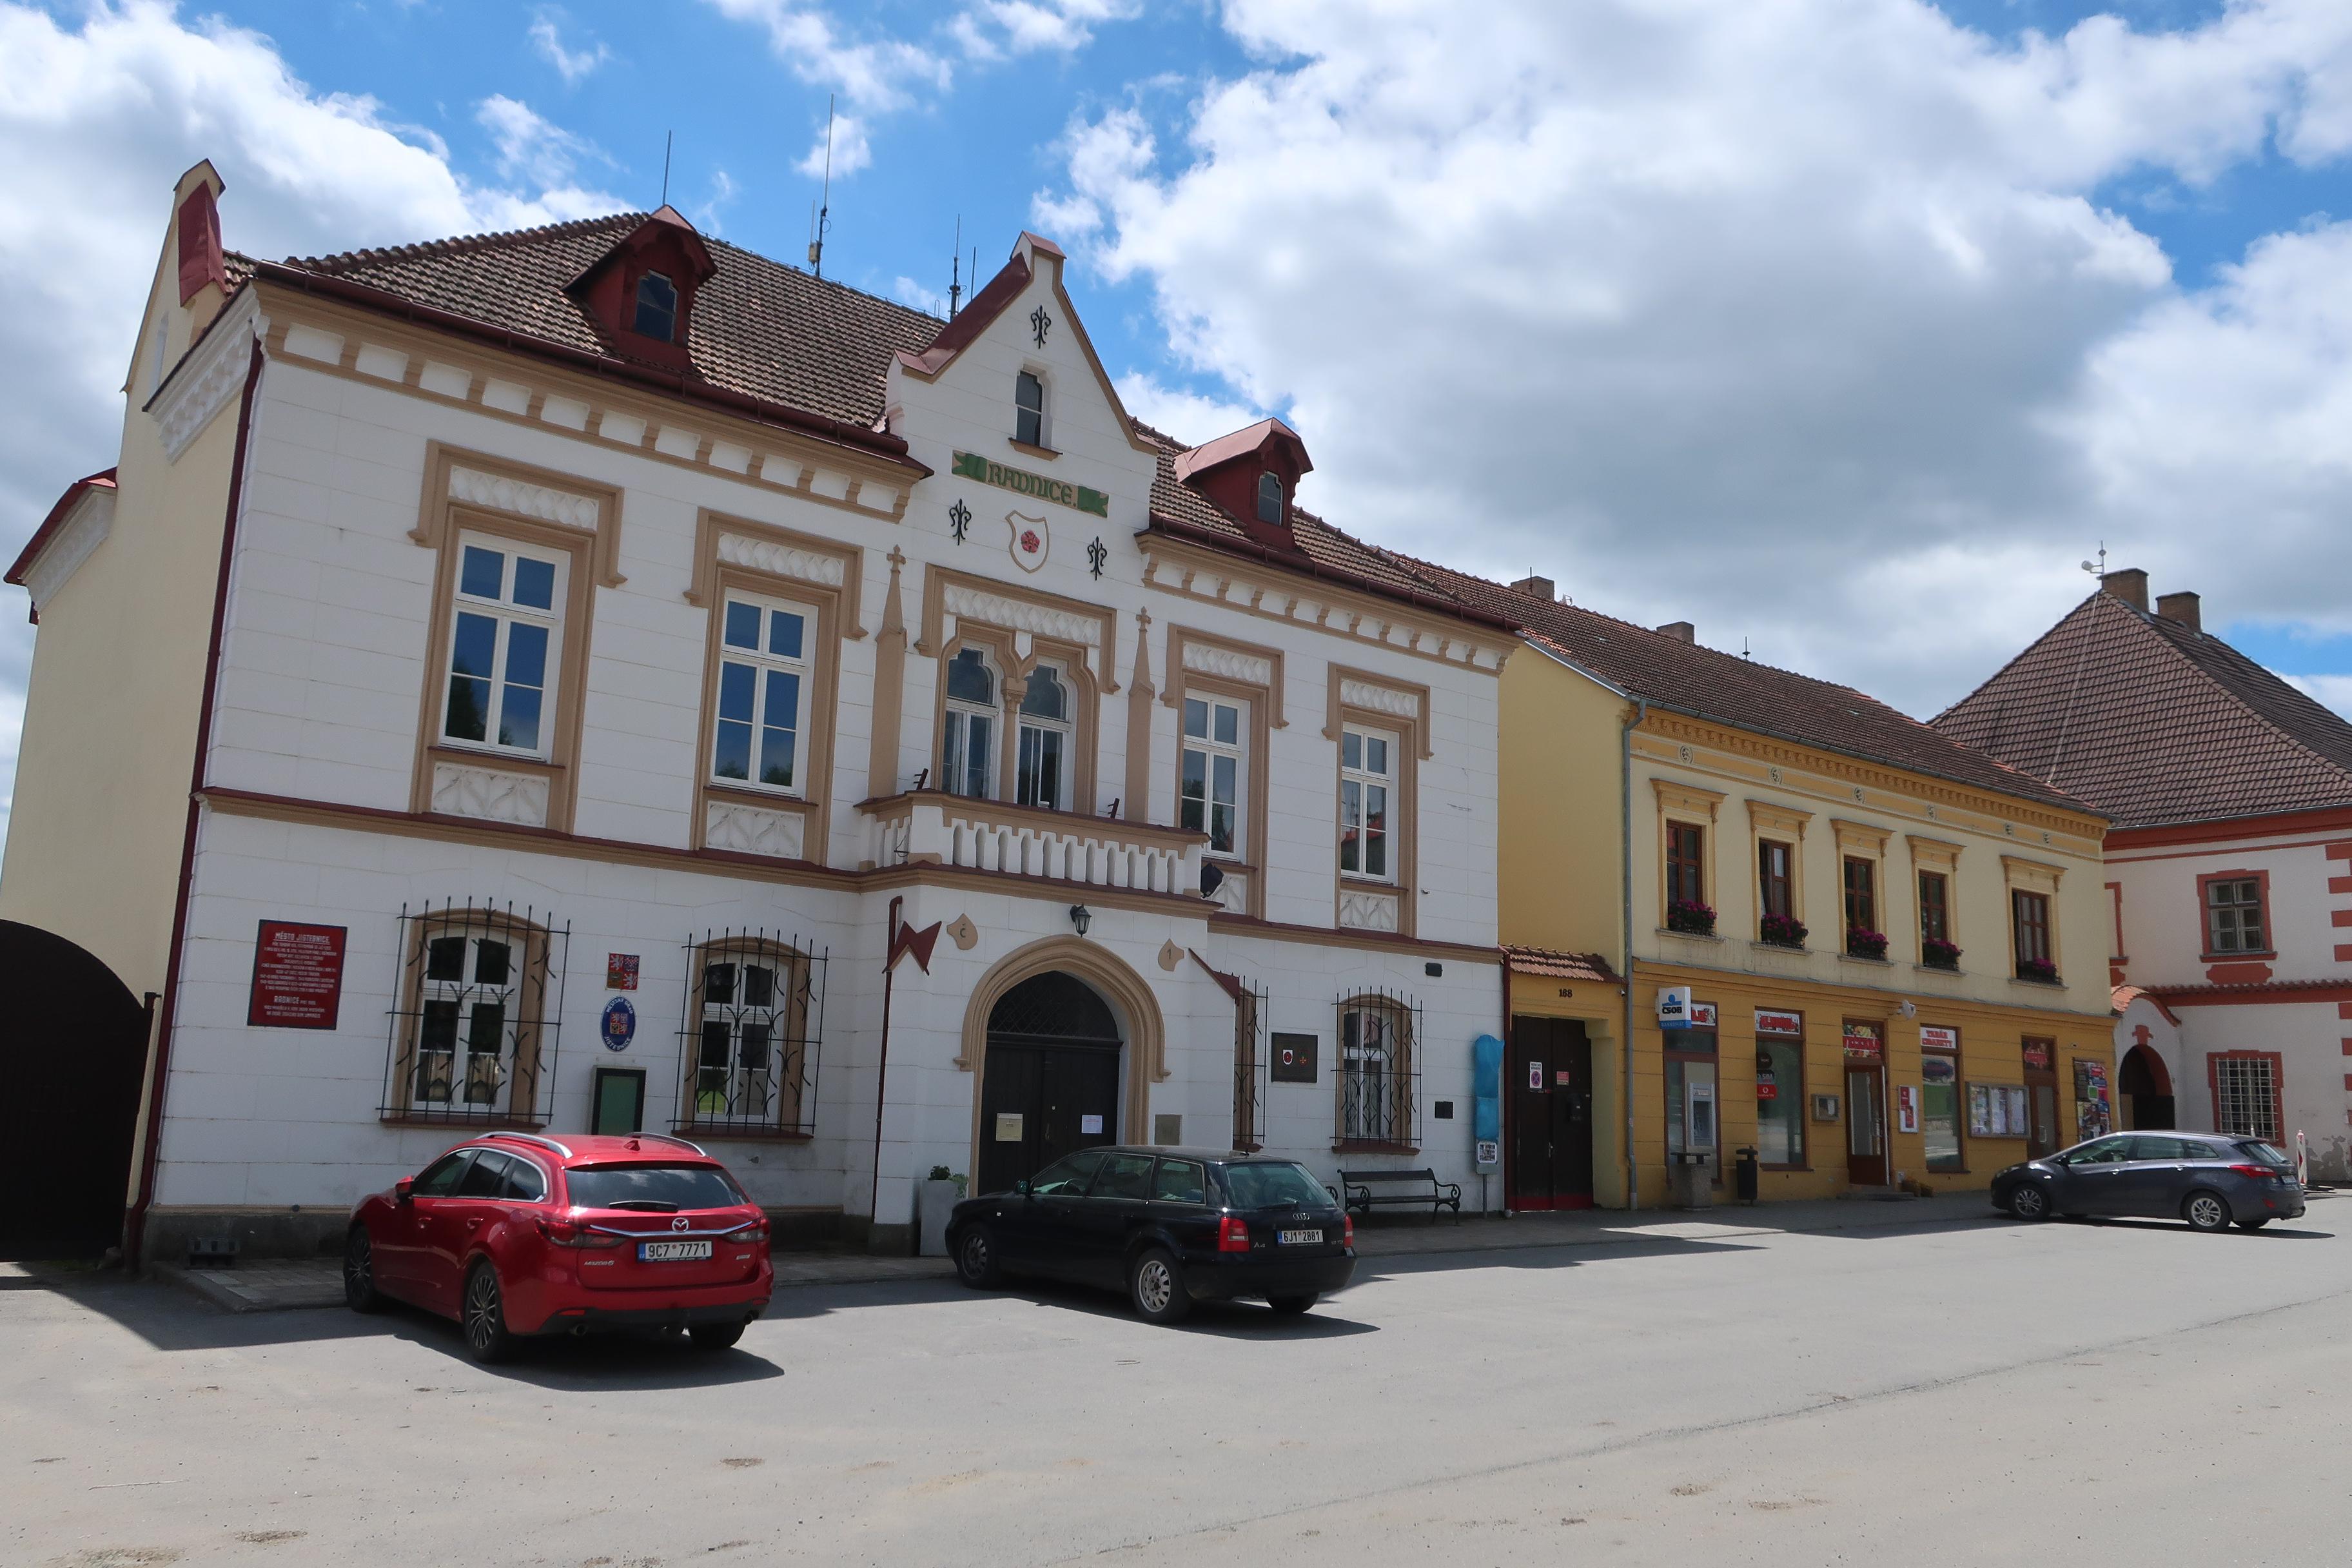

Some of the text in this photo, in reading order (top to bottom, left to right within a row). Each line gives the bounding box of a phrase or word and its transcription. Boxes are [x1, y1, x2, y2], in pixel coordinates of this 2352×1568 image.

[275, 931, 330, 943] MĚSTO JISTEBNICE
[1559, 988, 1573, 997] 168
[1284, 1231, 1297, 1242] 6J1
[649, 1242, 707, 1257] 9C7 7771
